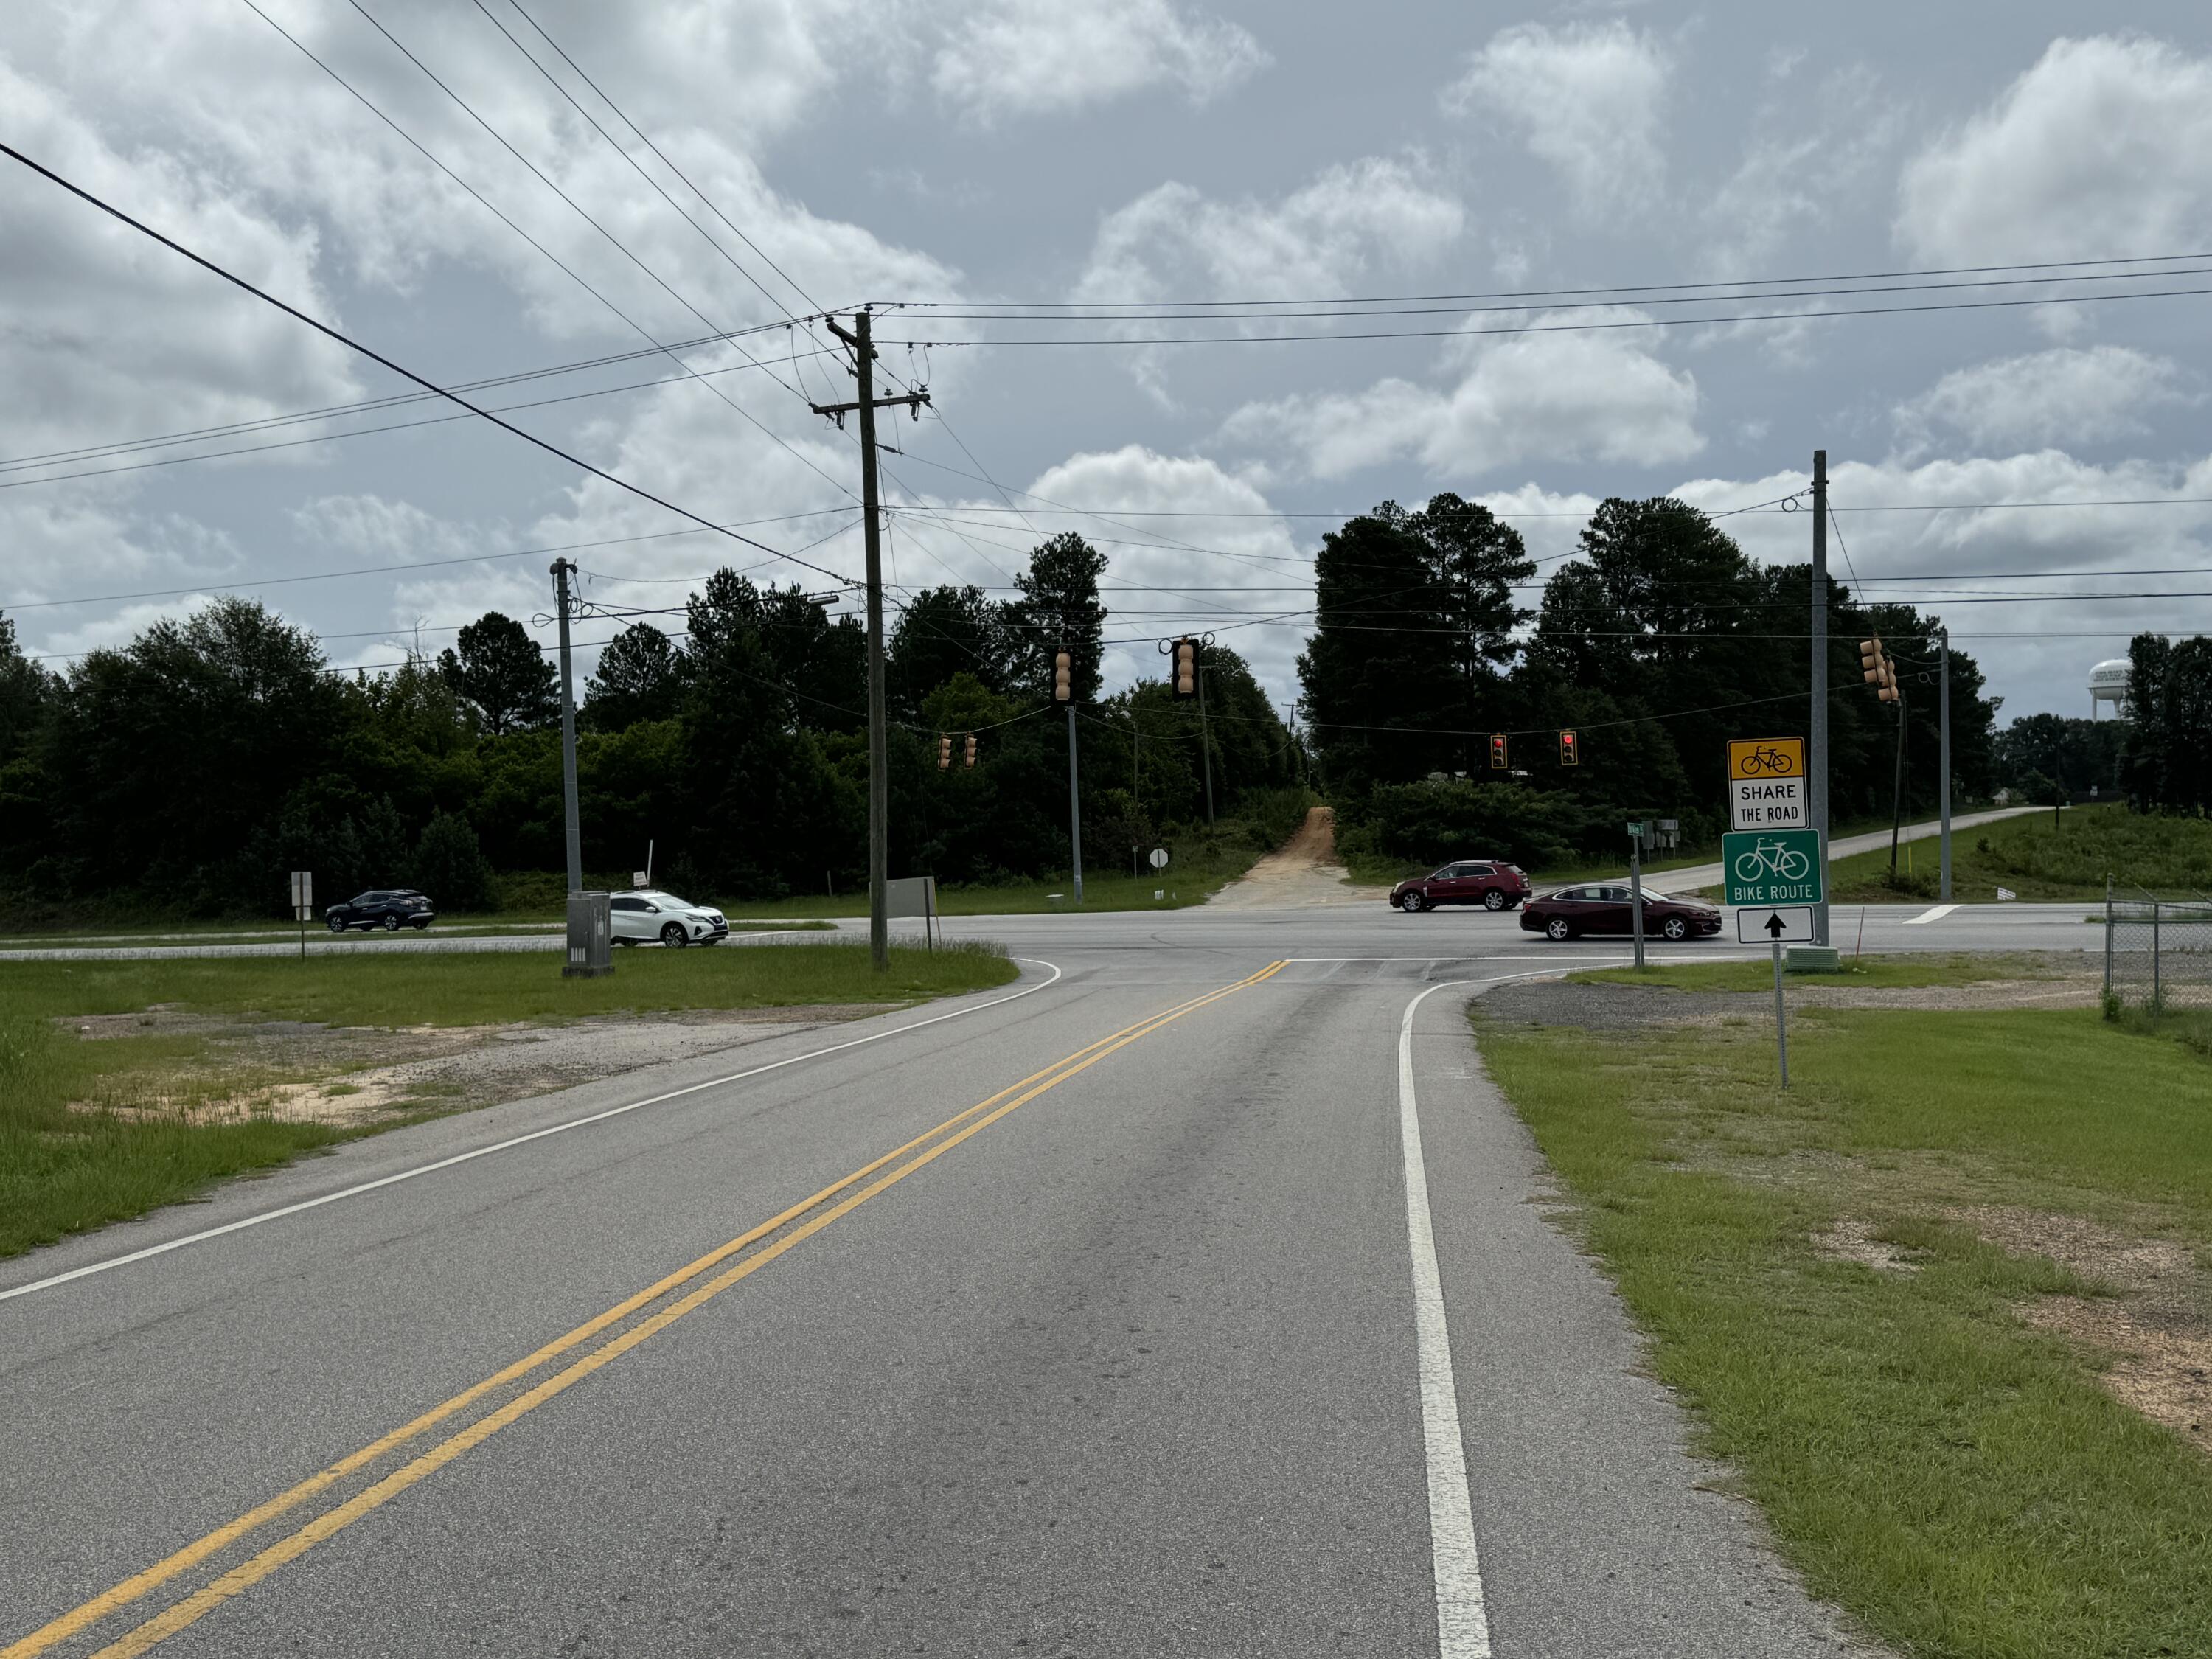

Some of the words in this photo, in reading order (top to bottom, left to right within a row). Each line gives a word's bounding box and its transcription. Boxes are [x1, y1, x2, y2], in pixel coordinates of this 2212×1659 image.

[1741, 785, 1797, 800] SHARE
[1741, 808, 1761, 822] THE
[1767, 806, 1798, 821] ROAD
[1734, 886, 1764, 900] BIKE
[1770, 884, 1813, 899] ROUTE
